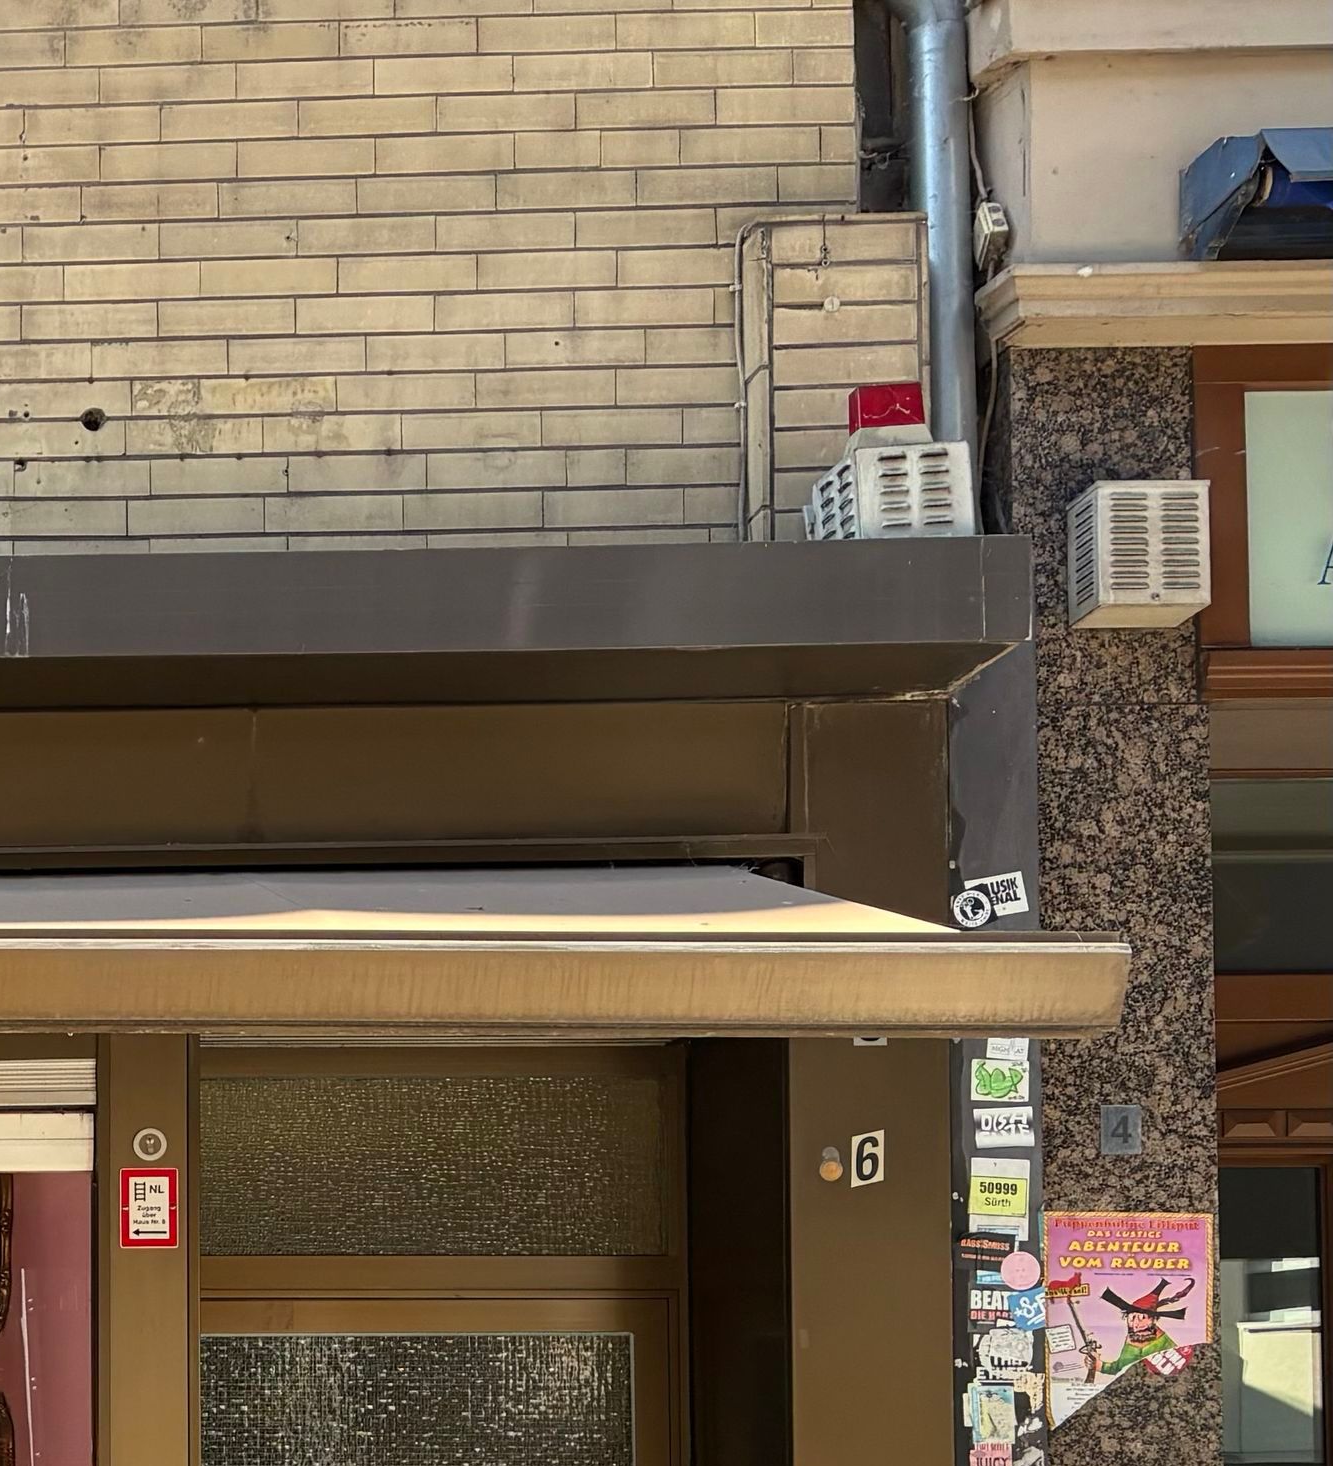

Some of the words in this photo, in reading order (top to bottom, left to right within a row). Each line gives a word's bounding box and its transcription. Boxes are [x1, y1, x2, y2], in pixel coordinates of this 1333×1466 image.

[989, 876, 1019, 896] USIK
[1111, 1115, 1132, 1144] 4
[855, 1135, 879, 1182] 6
[149, 1184, 165, 1194] NL
[979, 1181, 1018, 1196] 50999
[984, 1196, 1011, 1207] Sürth
[1087, 1230, 1111, 1238] DAS
[1115, 1230, 1162, 1239] LUSTIGE
[1068, 1240, 1181, 1253] ABENTEUER
[1059, 1256, 1103, 1269] VOM
[1110, 1253, 1191, 1270] RÄUBER
[970, 1310, 987, 1320] DIE
